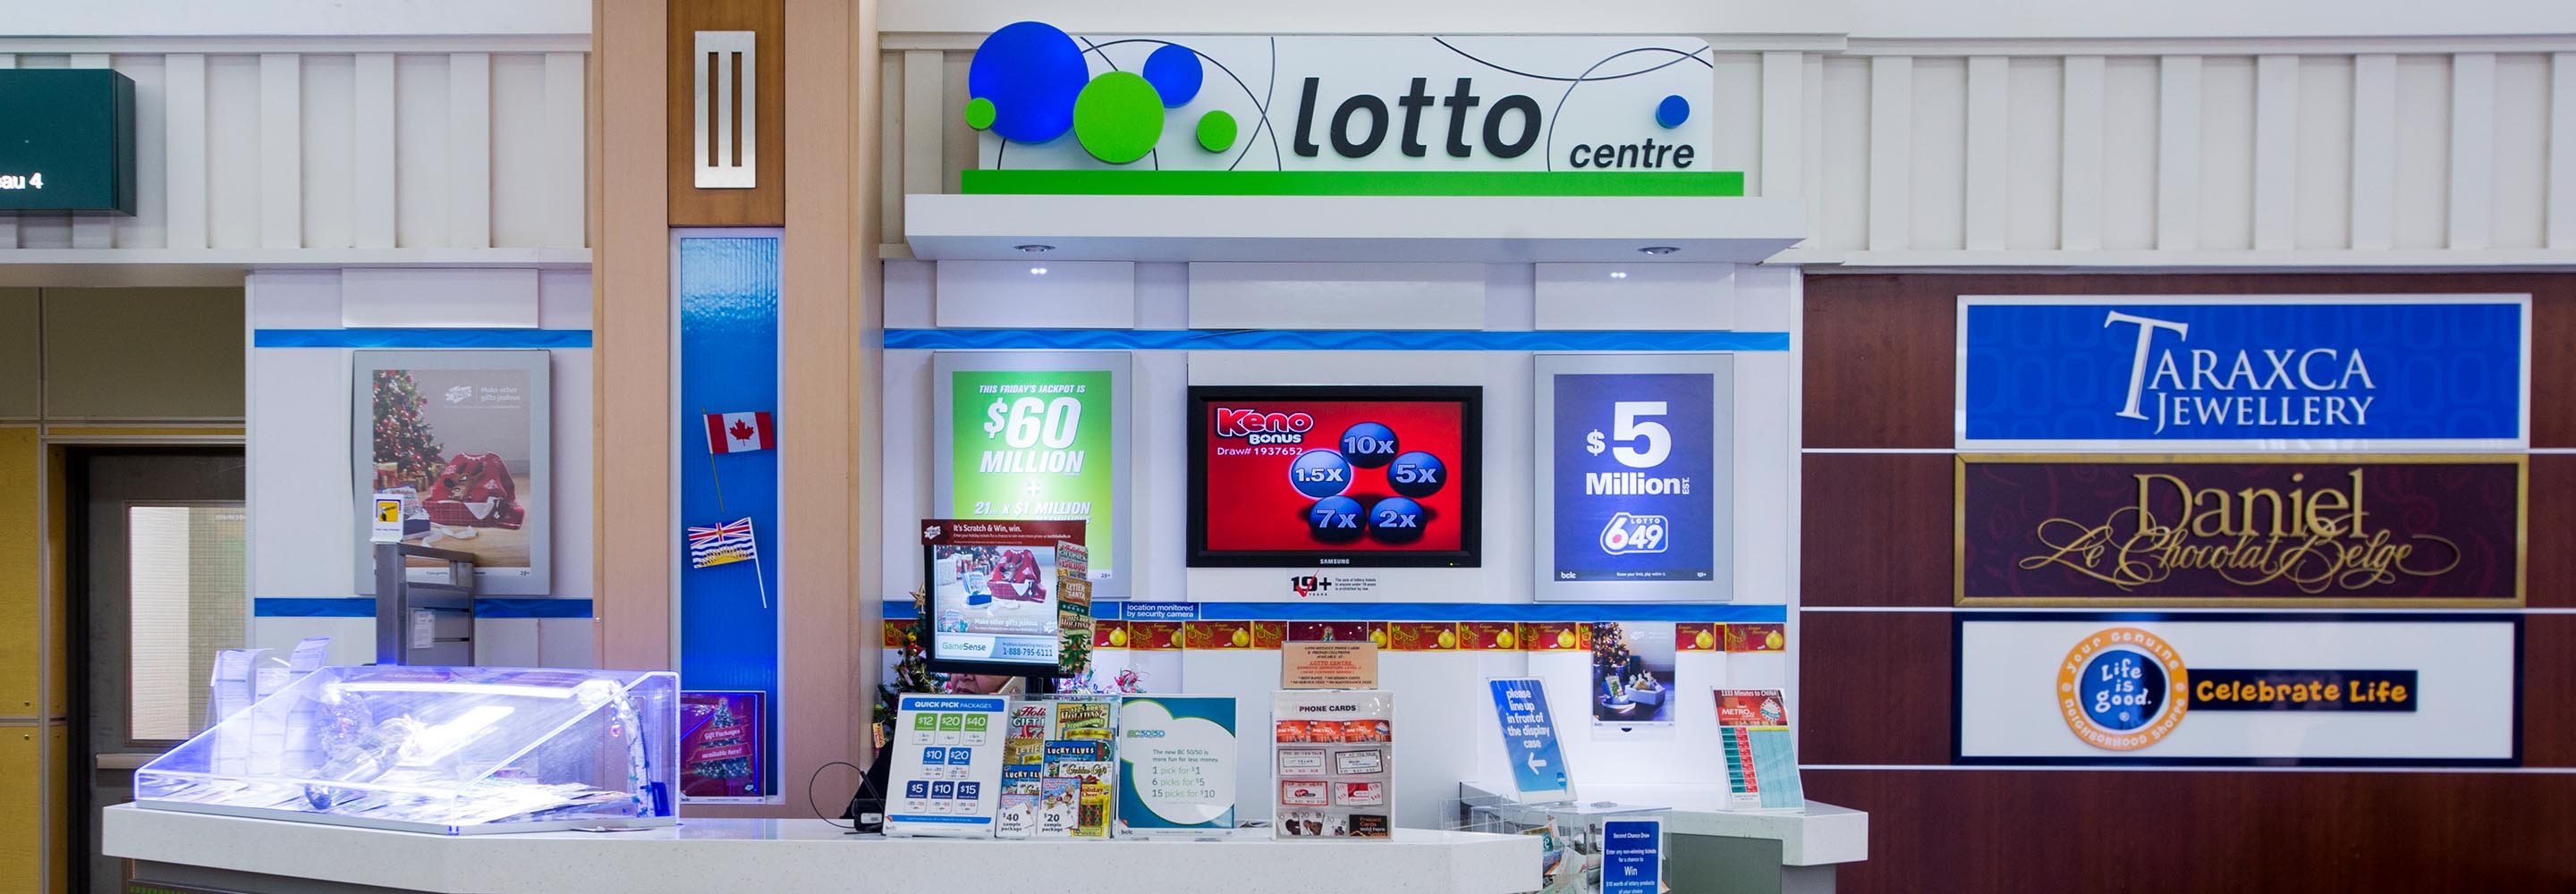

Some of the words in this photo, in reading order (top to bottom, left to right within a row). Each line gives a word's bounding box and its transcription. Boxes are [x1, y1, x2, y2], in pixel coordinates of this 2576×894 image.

[1293, 77, 1542, 158] lotto
[1570, 139, 1694, 168] centre
[29, 173, 44, 189] 4
[2104, 310, 2376, 420] TARAXCA
[979, 385, 997, 393] THIS
[1000, 385, 1036, 393] FRIDAY'S
[1038, 385, 1075, 393] JACKPOT
[1077, 385, 1086, 393] IS
[2154, 392, 2375, 435] JEWELLERY
[984, 397, 1082, 450] $60
[1216, 408, 1314, 437] Keno
[1249, 434, 1302, 445] BONUS
[1217, 447, 1252, 456] Draw#
[1254, 447, 1303, 456] 1937652
[979, 451, 1085, 474] MILLION
[1586, 472, 1681, 494] Million
[1035, 502, 1092, 515] MILLION
[2133, 468, 2368, 538] Daniel
[2019, 519, 2136, 585] Le
[2107, 507, 2283, 586] Chocolat
[2268, 511, 2461, 592] Belge
[1561, 571, 1577, 579] bclc
[1291, 576, 1332, 591] 19+
[1137, 611, 1165, 619] security
[942, 641, 987, 652] GameSense
[1003, 647, 1053, 657] 1-888-795-6111
[2101, 658, 2143, 682] Life
[2115, 679, 2134, 693] is
[2196, 680, 2341, 703] Celebrate
[2350, 680, 2409, 703] Life
[1505, 687, 1532, 699] please
[914, 701, 940, 709] QUICK
[1509, 699, 1524, 712] line
[1524, 702, 1536, 713] up
[2095, 688, 2152, 713] good.
[1299, 704, 1326, 713] PHONE
[918, 716, 934, 726] $12
[942, 716, 961, 726] $20
[967, 716, 987, 727] $40
[1505, 713, 1515, 724] in
[1514, 713, 1536, 724] front
[1536, 712, 1545, 723] of
[1507, 725, 1522, 737] the
[1522, 724, 1551, 738] display
[1523, 739, 1542, 748] case
[926, 750, 943, 760] $10
[950, 750, 969, 760] $20
[1005, 771, 1028, 779] LUCKY
[1152, 766, 1157, 774] 1
[1160, 766, 1176, 776] pick
[1178, 766, 1189, 774] for
[1191, 766, 1200, 775] $1
[911, 783, 923, 793] $5
[1152, 778, 1158, 786] 6
[1160, 778, 1181, 787] picks
[1182, 778, 1193, 786] for
[1195, 778, 1205, 787] $5
[934, 784, 952, 794] $10
[960, 785, 977, 795] $15
[1152, 789, 1163, 797] 15
[1165, 789, 1185, 798] picks
[1187, 789, 1198, 797] for
[1200, 789, 1216, 798] $10
[1003, 813, 1019, 822] $40
[1044, 813, 1060, 822] $20
[1623, 865, 1638, 876] Win
